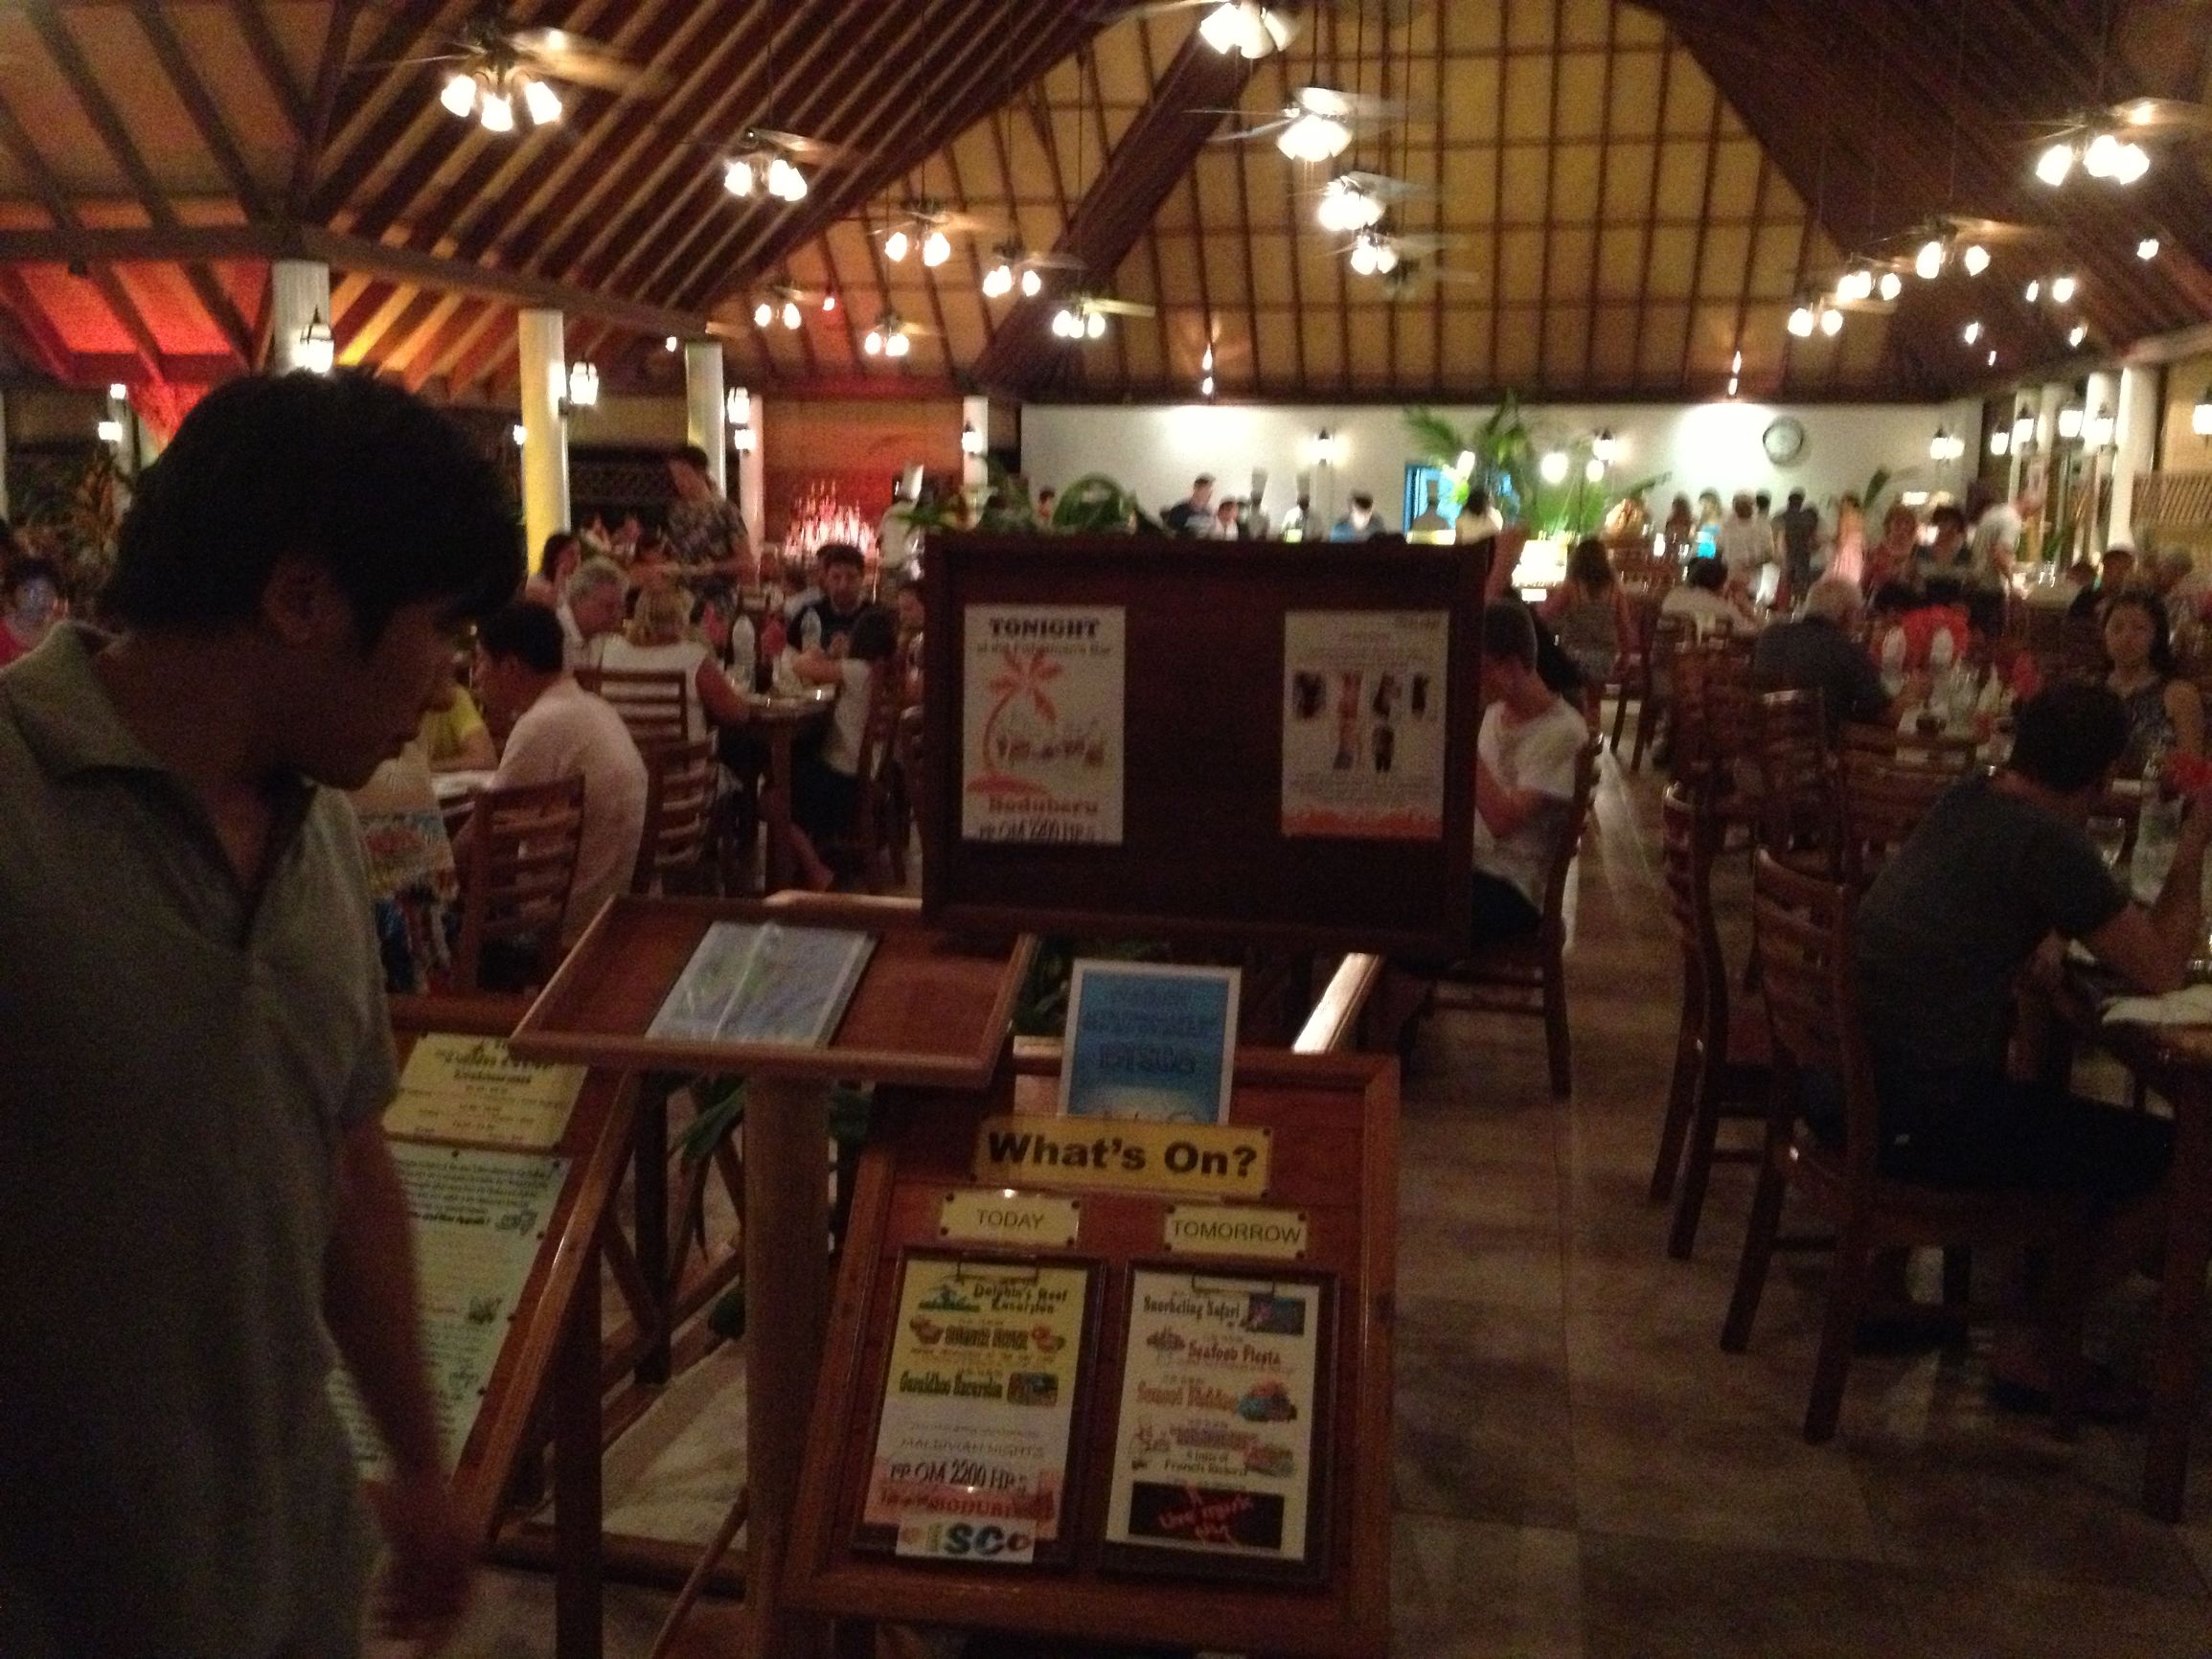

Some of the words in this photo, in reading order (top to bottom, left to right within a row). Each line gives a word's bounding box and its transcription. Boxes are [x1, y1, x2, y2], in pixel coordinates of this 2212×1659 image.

[989, 618, 1100, 637] TONIGHT
[988, 1130, 1147, 1170] What's
[1164, 1141, 1258, 1178] On?
[976, 1208, 1045, 1231] TODAY
[1172, 1219, 1302, 1243] TOMORROW
[890, 1462, 945, 1483] FROM
[949, 1458, 987, 1488] 2200
